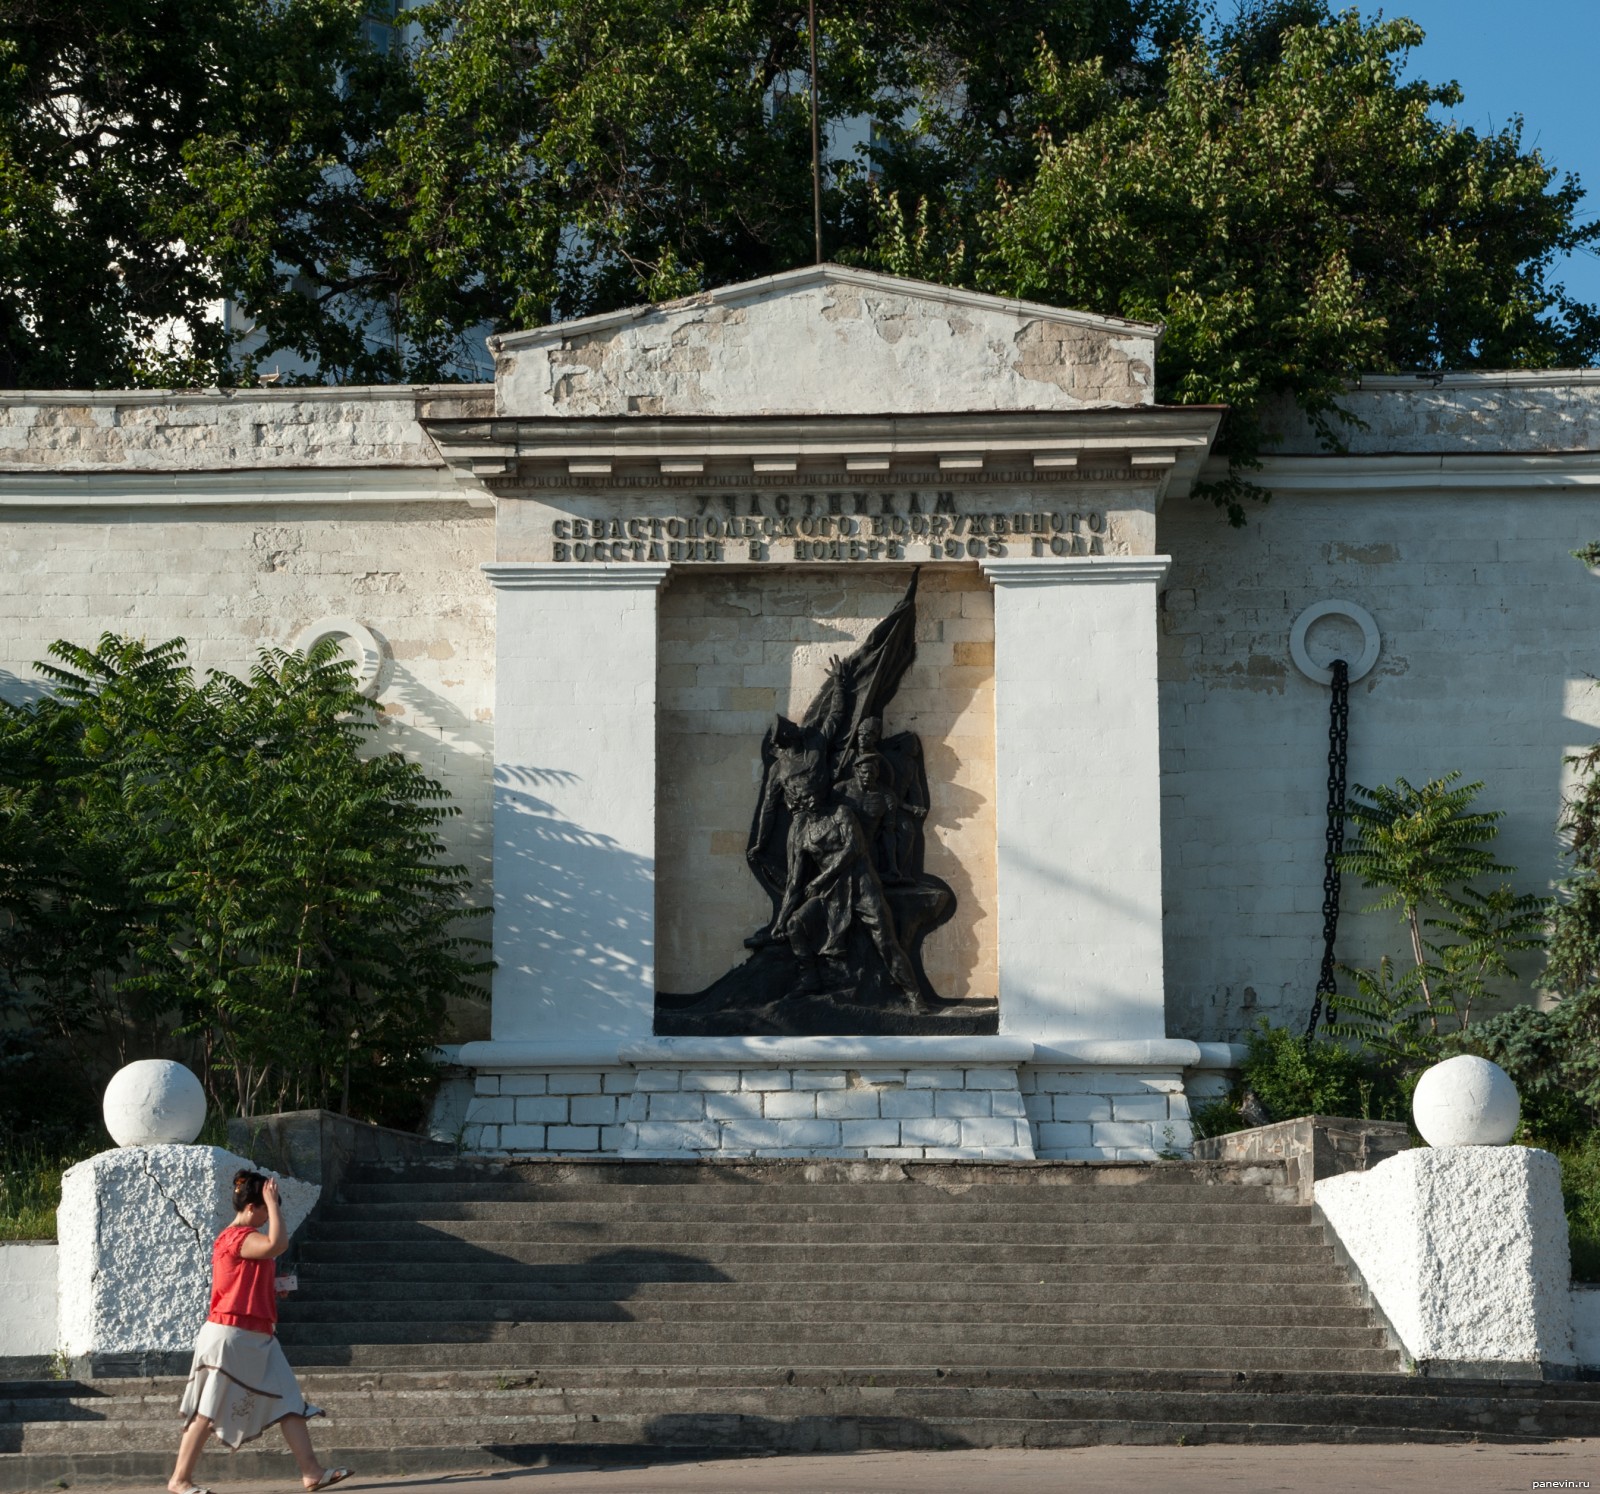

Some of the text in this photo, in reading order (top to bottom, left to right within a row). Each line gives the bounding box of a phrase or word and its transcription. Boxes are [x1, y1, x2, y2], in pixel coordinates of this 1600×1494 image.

[697, 492, 956, 516] УЧАСТНИКАМ
[552, 512, 1101, 539] СЕВАСТОПОЛЬСКОГО ВООРУЖЕННОГО
[552, 535, 1102, 563] ВОССТАНИЯ В НОЯБРЕ 1905 ГОДА
